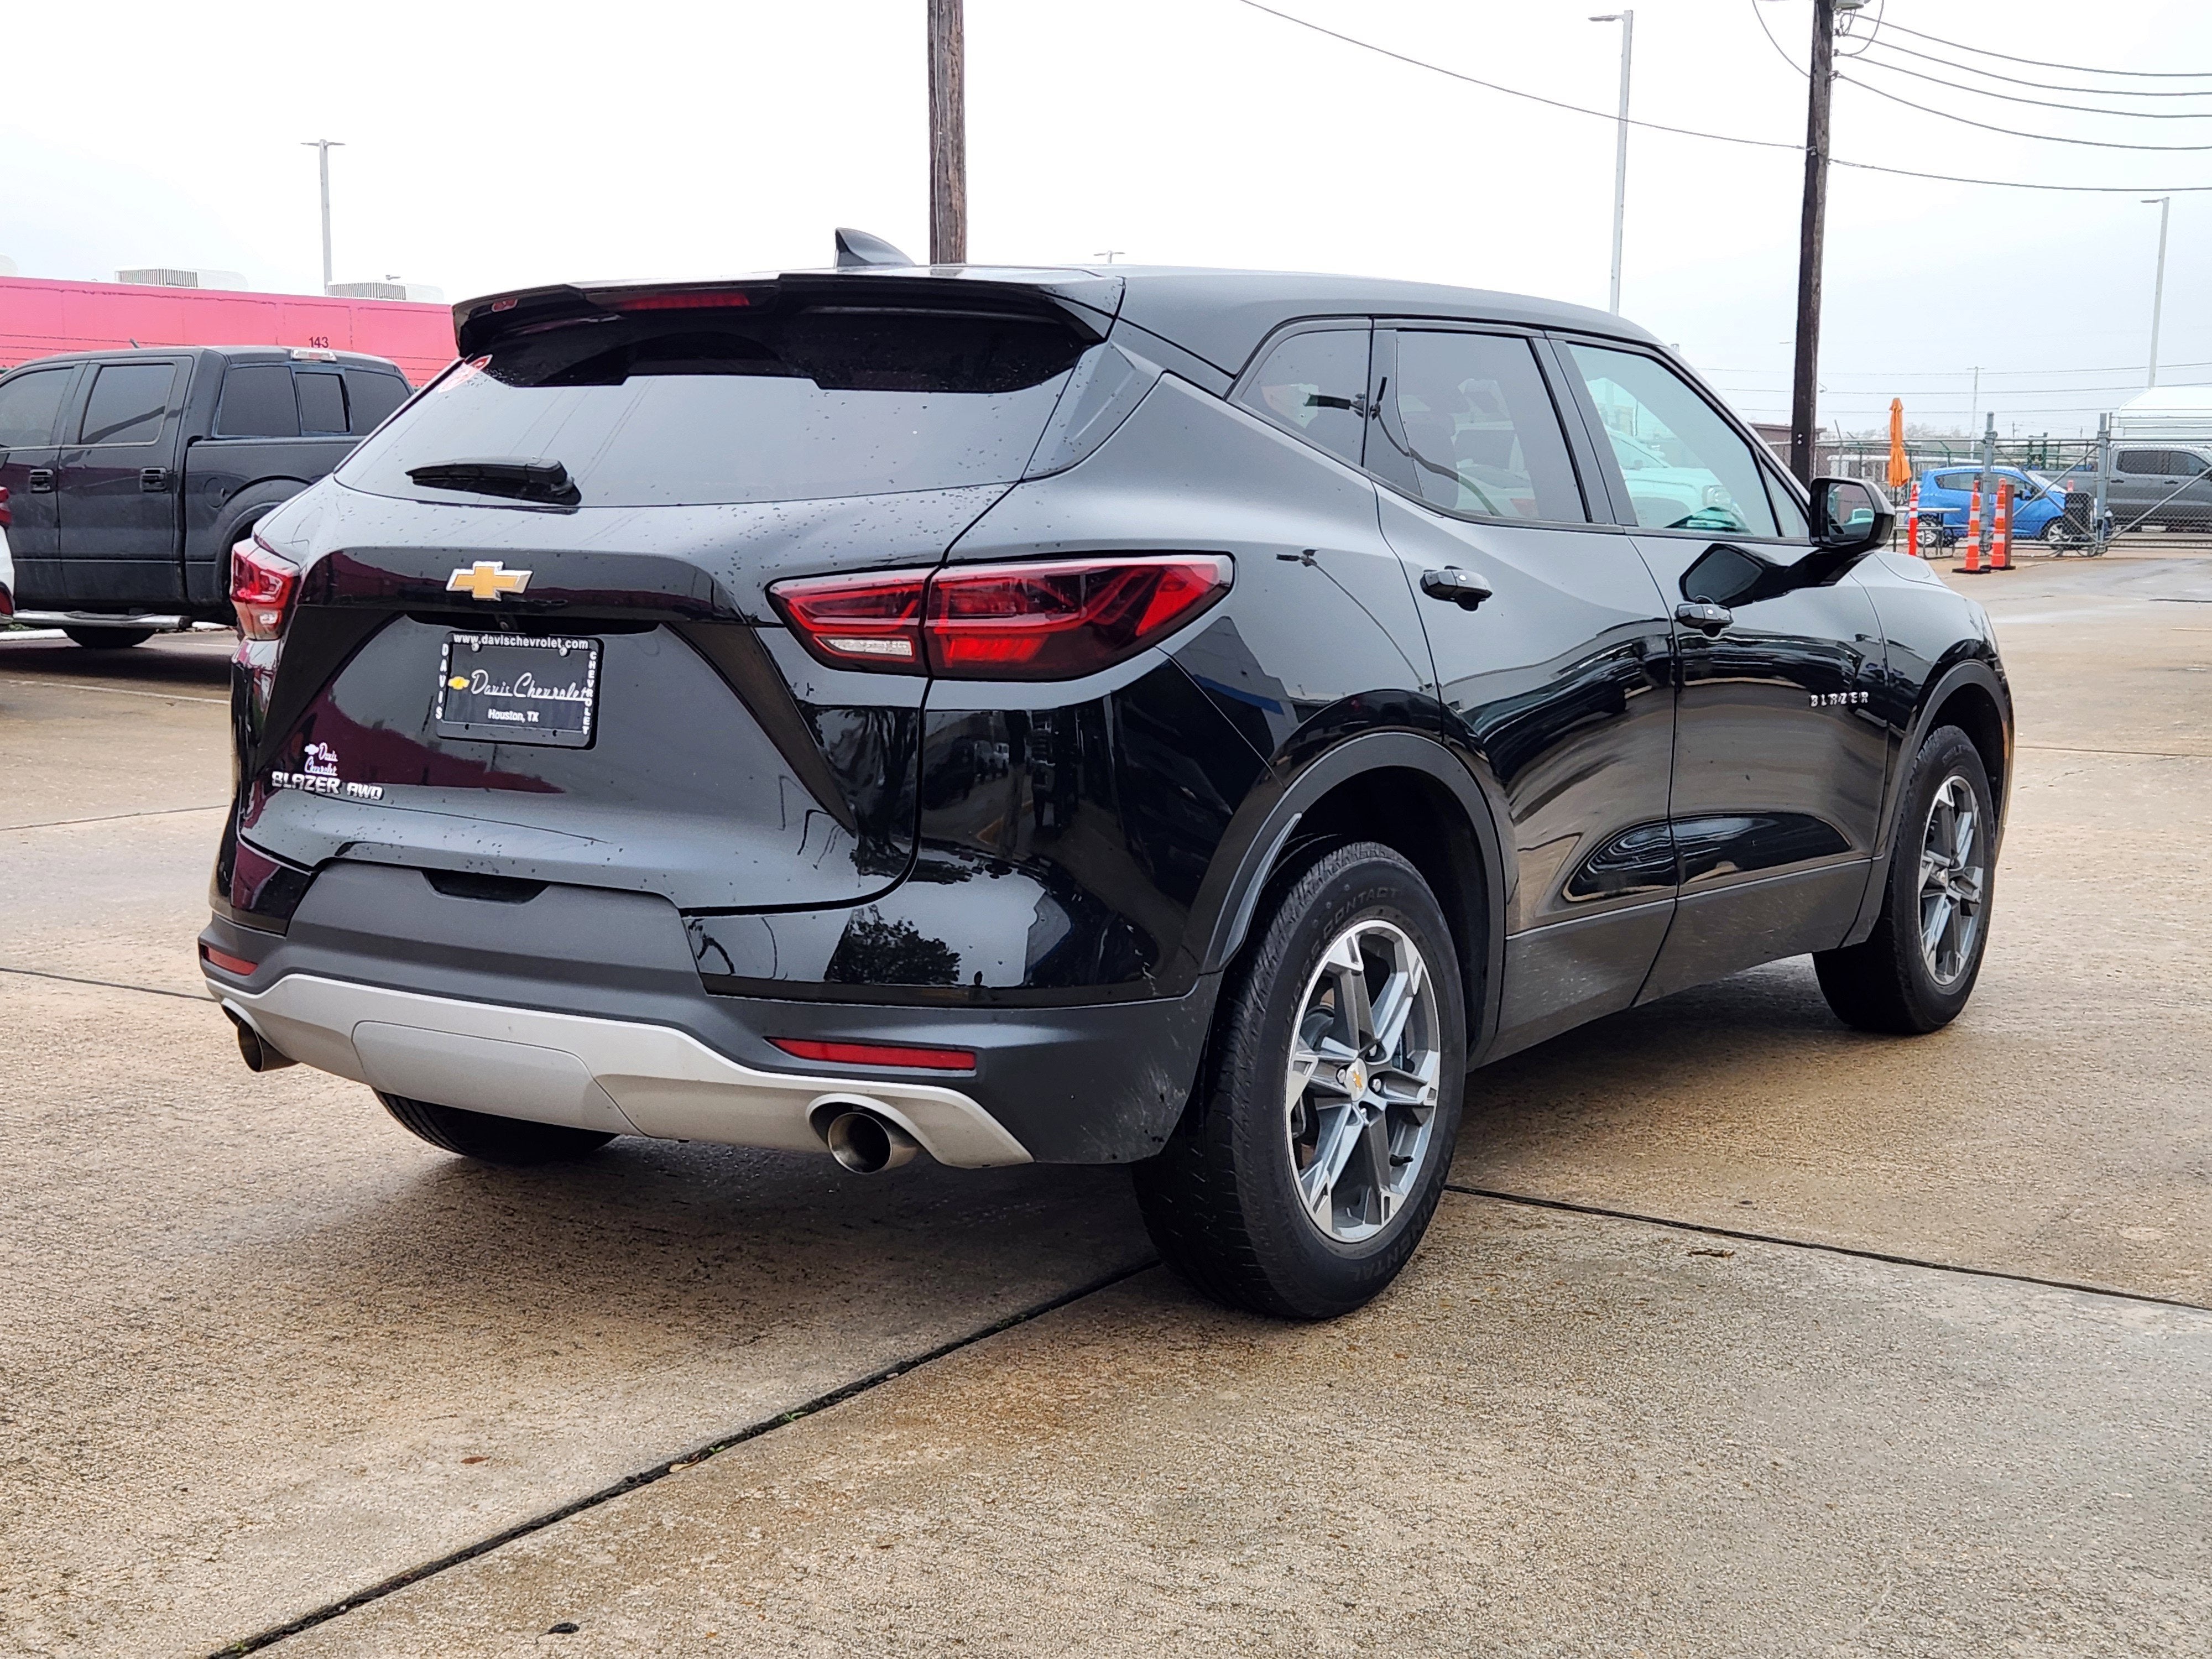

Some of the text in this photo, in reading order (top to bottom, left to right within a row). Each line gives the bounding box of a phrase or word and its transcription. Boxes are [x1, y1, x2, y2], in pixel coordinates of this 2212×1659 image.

[309, 336, 329, 348] 143
[453, 634, 589, 649] www.davischevrolet.com
[435, 643, 449, 719] DAVIS
[471, 669, 588, 701] Davis Chevrolet
[582, 651, 597, 735] CHEVROLET
[1810, 691, 1869, 707] BLAZER
[488, 708, 540, 723] Houston, TX
[272, 771, 384, 801] BLAZER AWD
